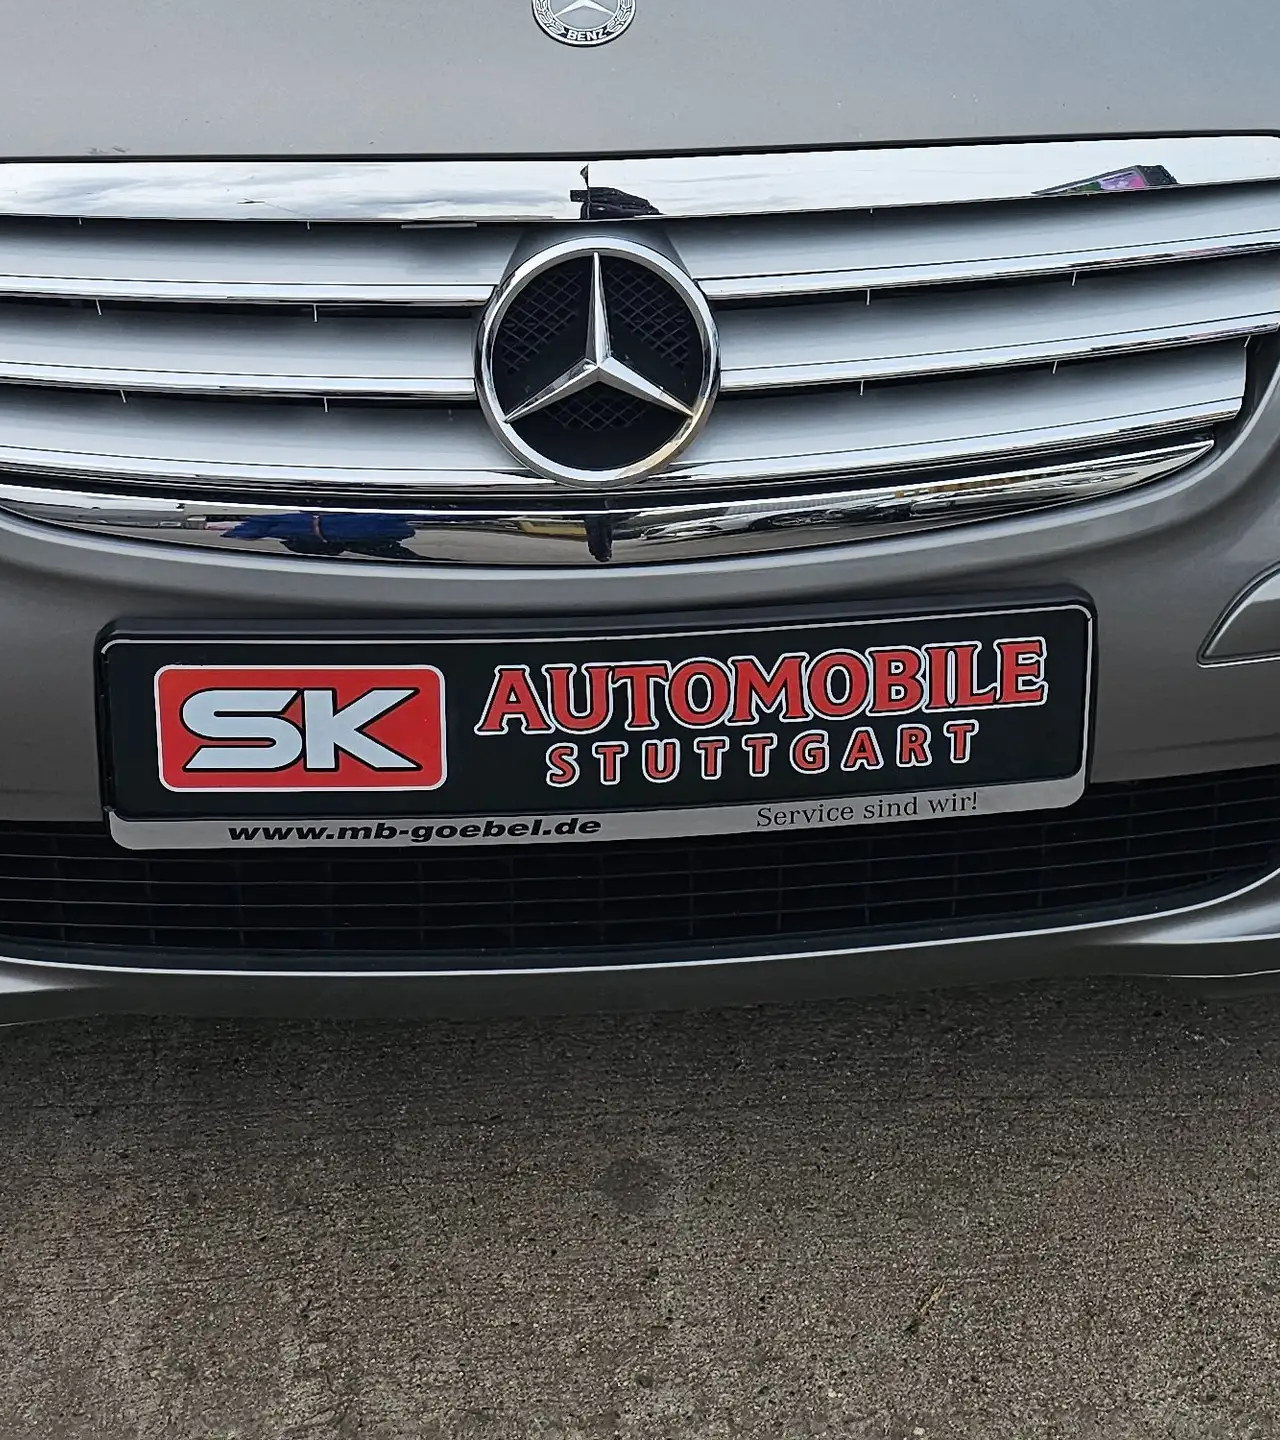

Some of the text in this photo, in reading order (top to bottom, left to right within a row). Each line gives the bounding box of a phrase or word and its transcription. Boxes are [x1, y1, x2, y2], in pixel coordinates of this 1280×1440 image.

[566, 28, 609, 41] BENZ
[181, 637, 1049, 772] SK AUTOMOBILE
[546, 720, 979, 788] STUTTGART
[756, 791, 979, 829] Service sind wir!
[227, 816, 602, 844] www.mb-goebel.de
